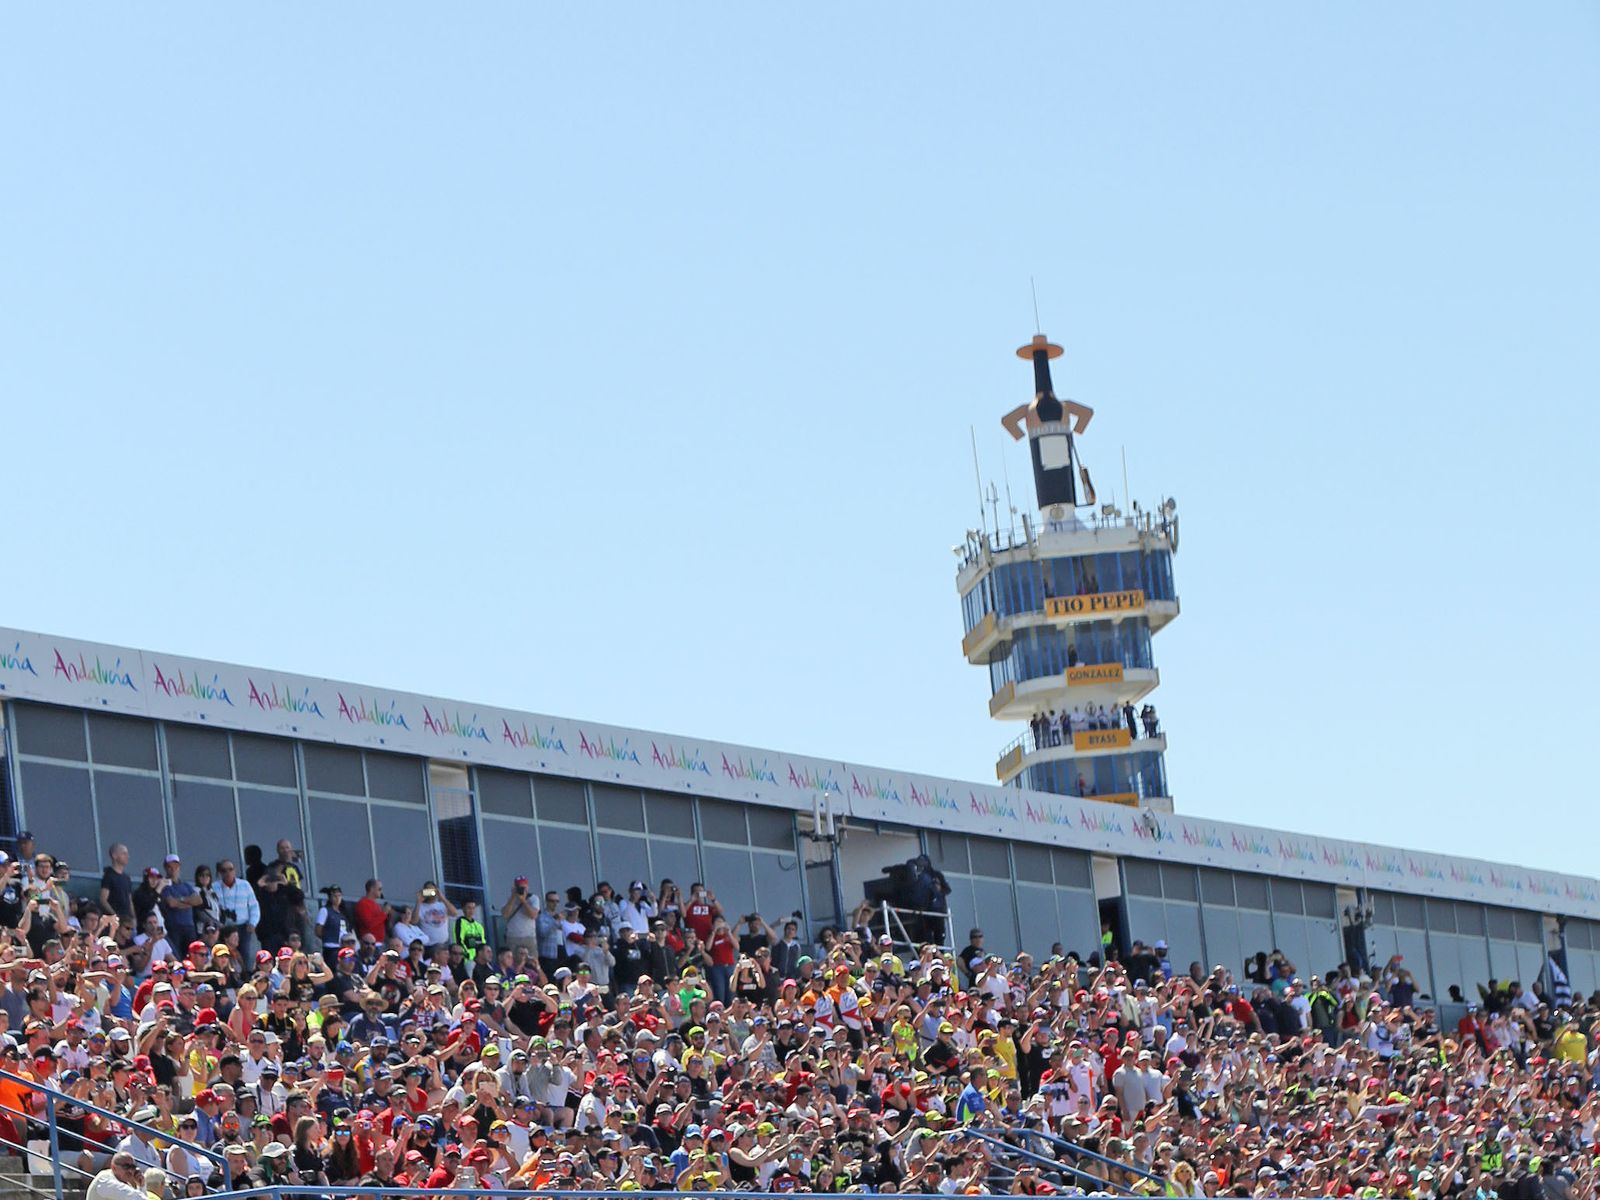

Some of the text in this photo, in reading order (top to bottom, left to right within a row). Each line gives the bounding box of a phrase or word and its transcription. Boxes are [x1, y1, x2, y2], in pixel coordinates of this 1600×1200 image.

[1050, 592, 1141, 614] TIO PEPE
[1069, 666, 1121, 682] GONZALEZ
